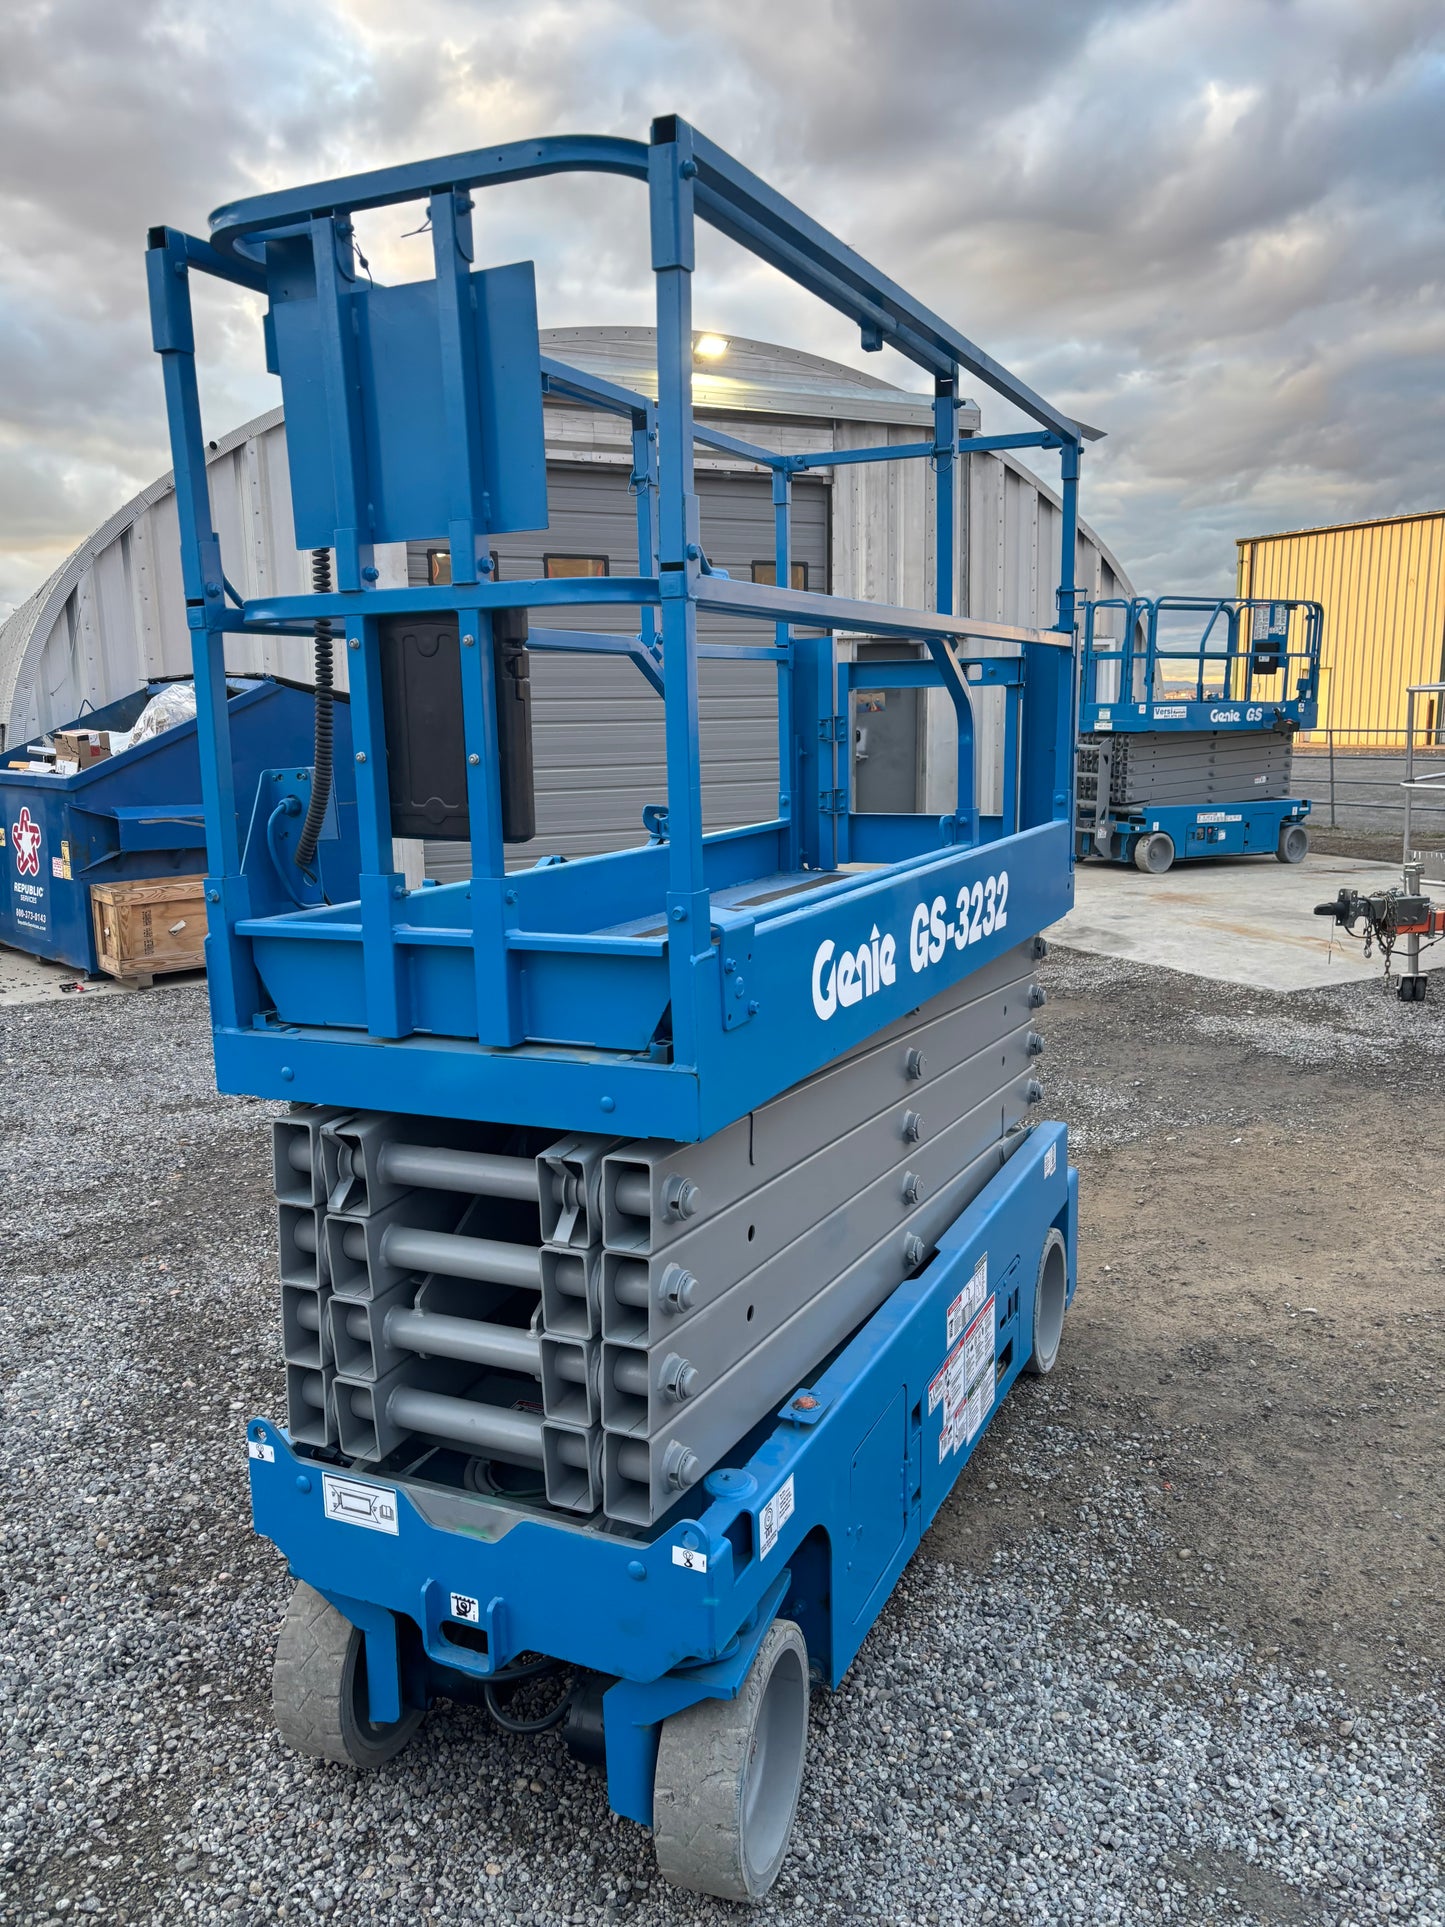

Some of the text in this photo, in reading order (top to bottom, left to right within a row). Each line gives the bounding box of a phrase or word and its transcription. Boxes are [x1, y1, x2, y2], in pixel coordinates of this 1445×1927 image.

[1210, 708, 1240, 723] Genie
[1246, 707, 1263, 722] GS
[14, 881, 44, 898] REPUBLIC
[812, 871, 1009, 1020] Genie GS-3232
